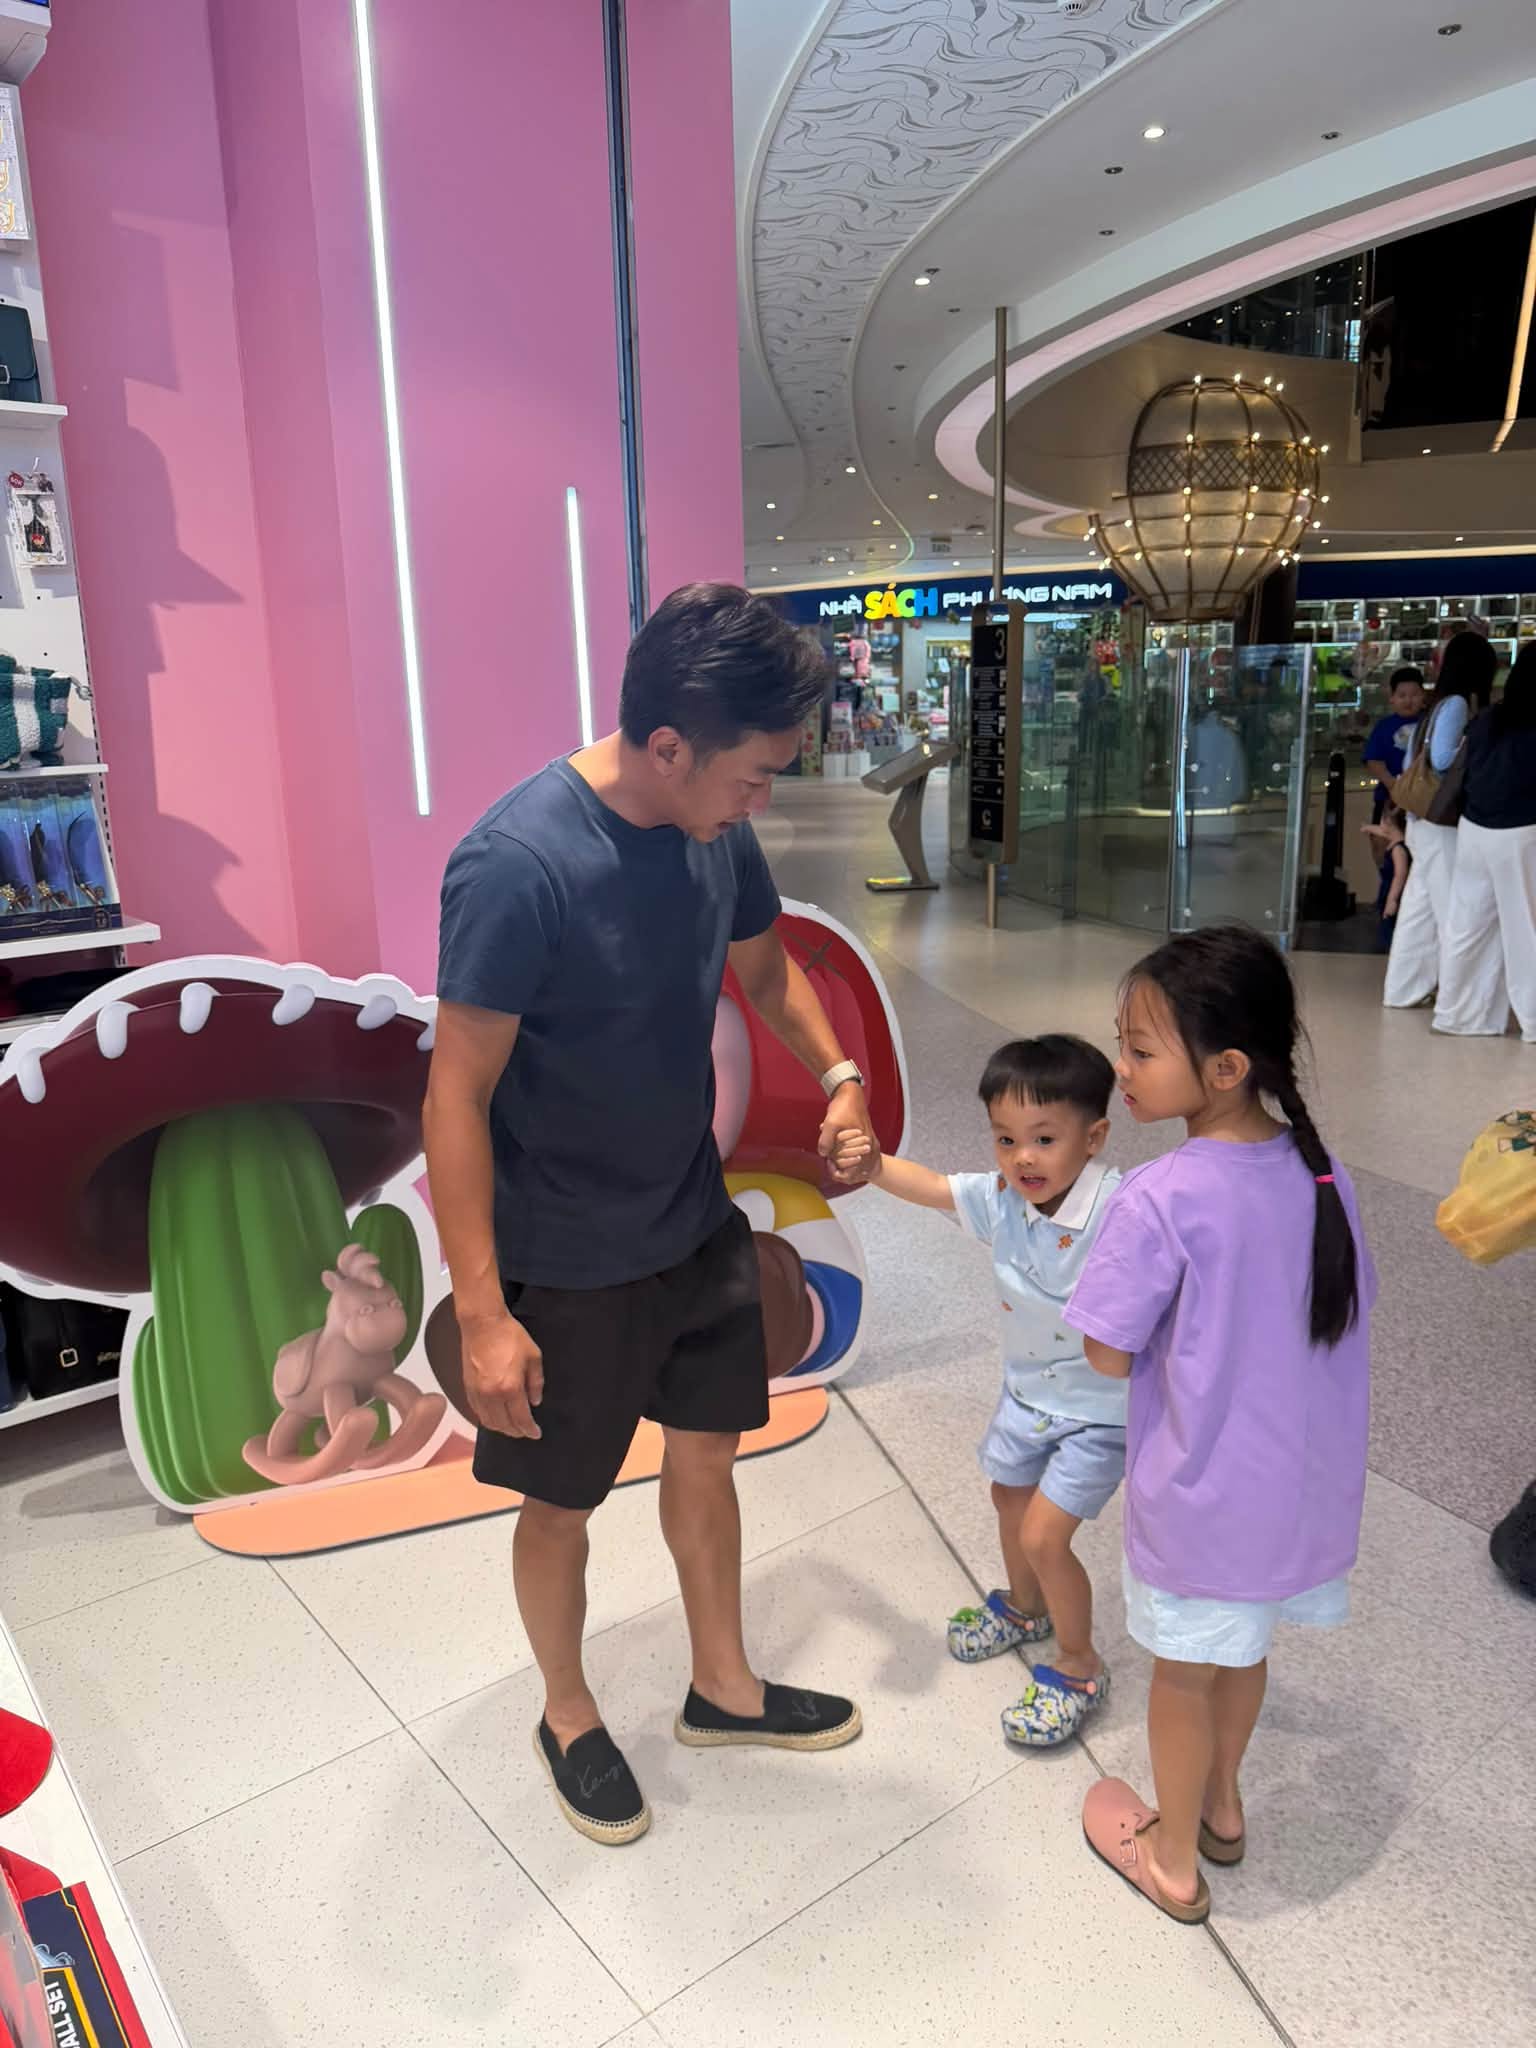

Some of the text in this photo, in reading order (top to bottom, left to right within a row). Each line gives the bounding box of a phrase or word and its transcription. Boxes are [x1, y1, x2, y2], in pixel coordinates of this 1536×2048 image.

[820, 594, 862, 616] NHÀ
[864, 582, 938, 620] SÁCH
[1052, 583, 1112, 601] NAM
[995, 630, 1005, 659] 3
[44, 1981, 80, 2048] ALL SET
